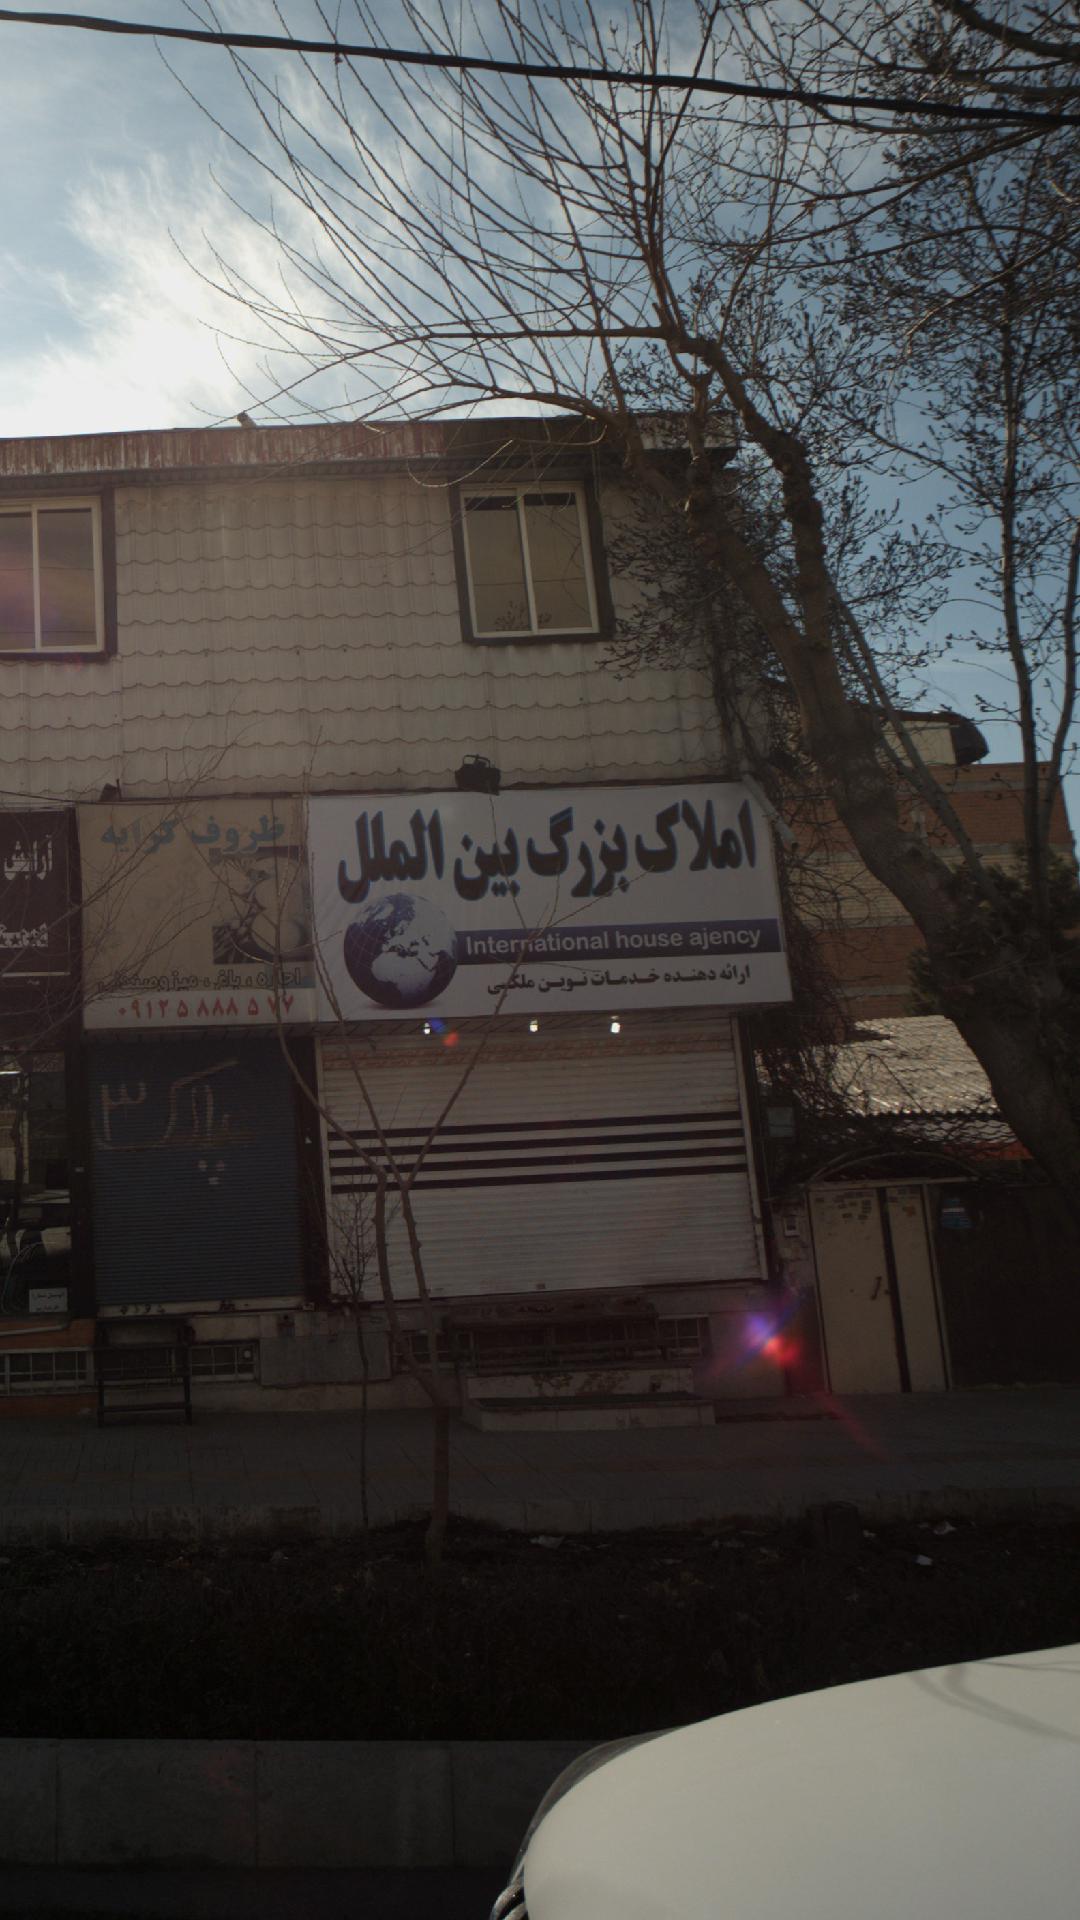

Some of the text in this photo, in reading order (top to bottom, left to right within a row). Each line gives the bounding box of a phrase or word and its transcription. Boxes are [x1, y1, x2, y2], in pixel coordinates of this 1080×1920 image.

[100, 815, 286, 854] ظروف کرایه
[337, 799, 756, 904] املاک بزرگ بین الملل
[466, 927, 761, 955] International house ajency
[487, 964, 751, 994] ارائه دهنده خدمات نوین ملکی
